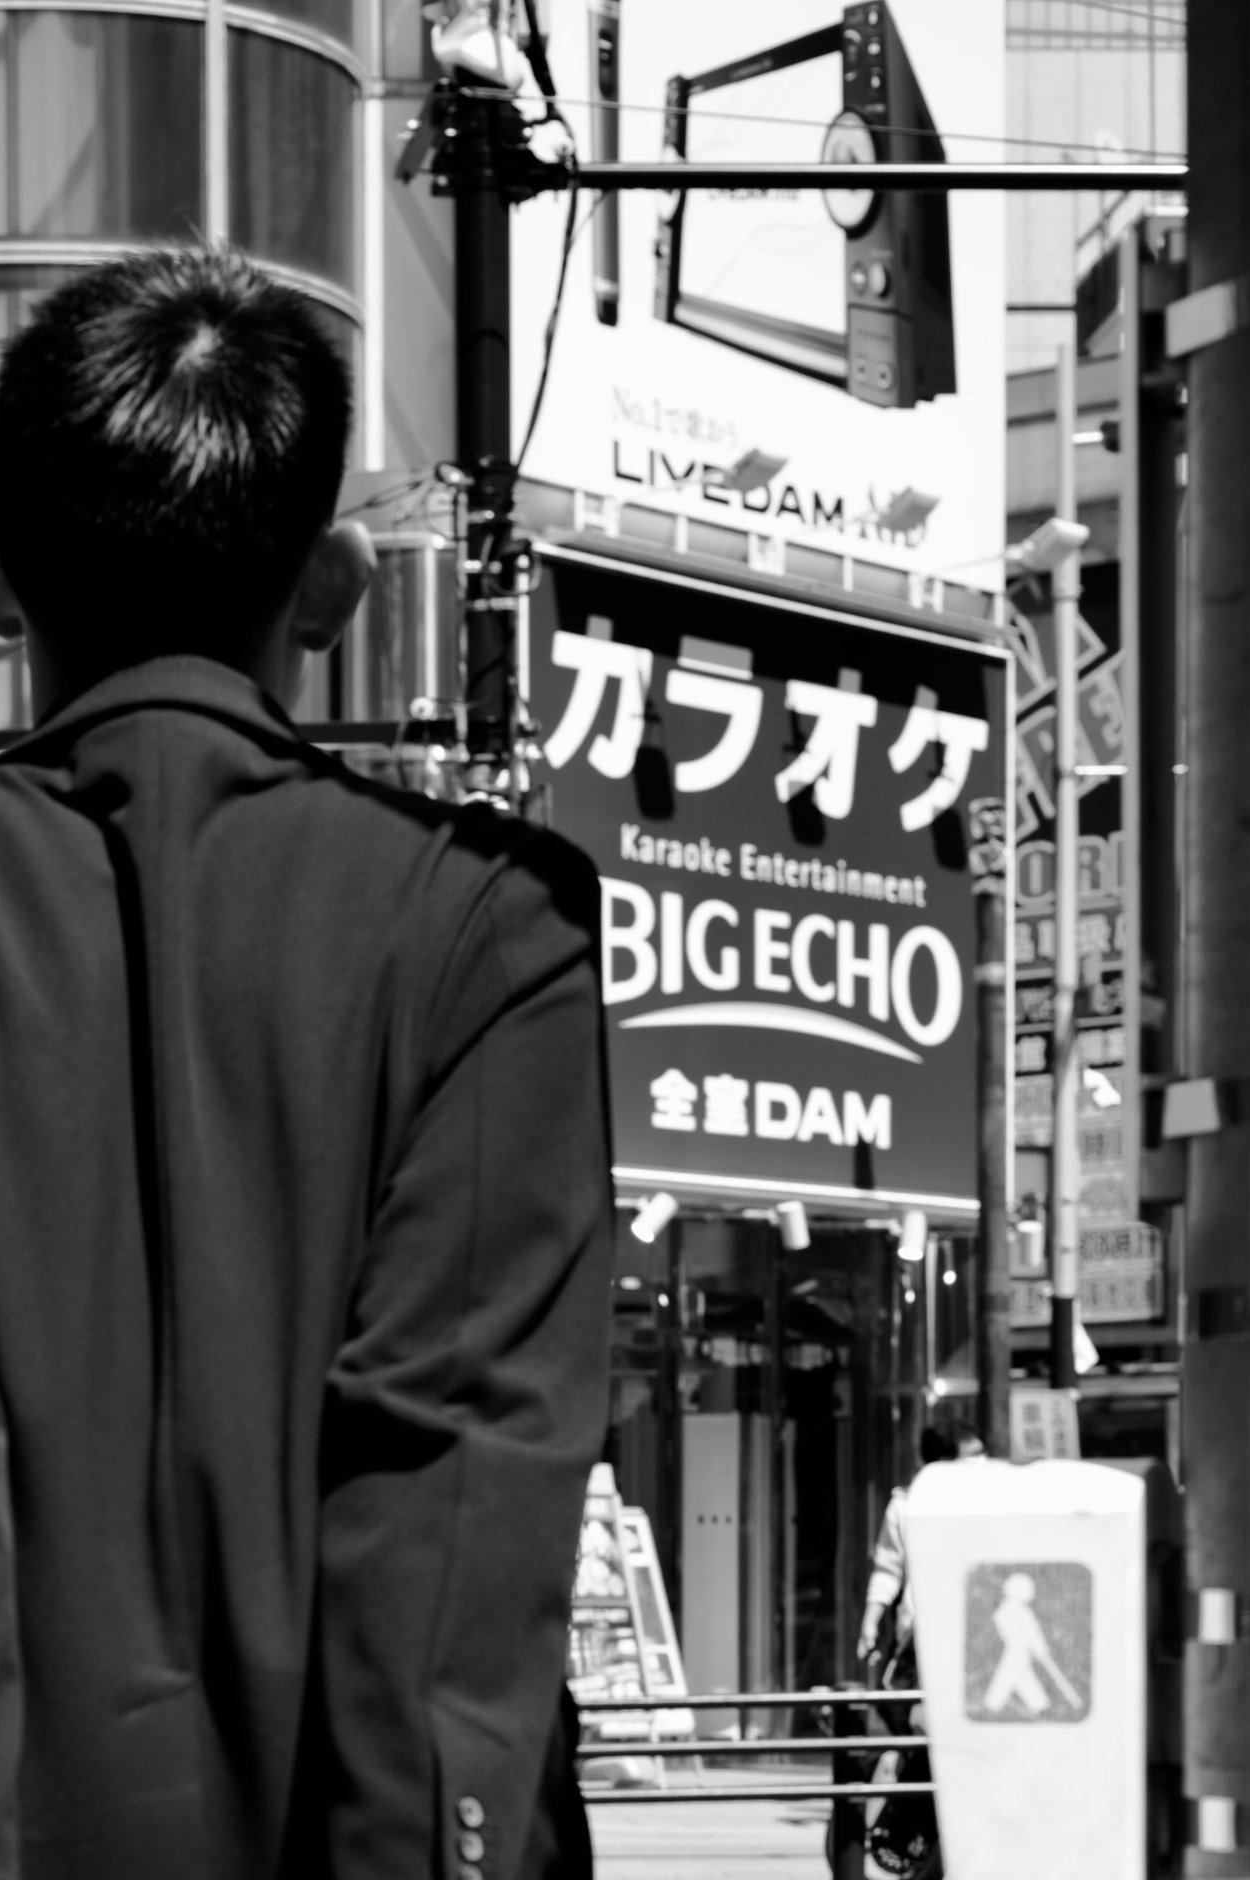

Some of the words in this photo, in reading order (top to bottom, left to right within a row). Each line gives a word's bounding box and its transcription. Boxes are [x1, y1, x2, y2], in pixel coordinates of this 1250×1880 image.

[742, 476, 845, 534] DAM
[545, 630, 989, 832] カラオケ
[620, 823, 732, 877] Karaoke
[739, 843, 927, 908] Entertainment
[601, 876, 740, 1005] BIG
[753, 907, 963, 1047] ECHO
